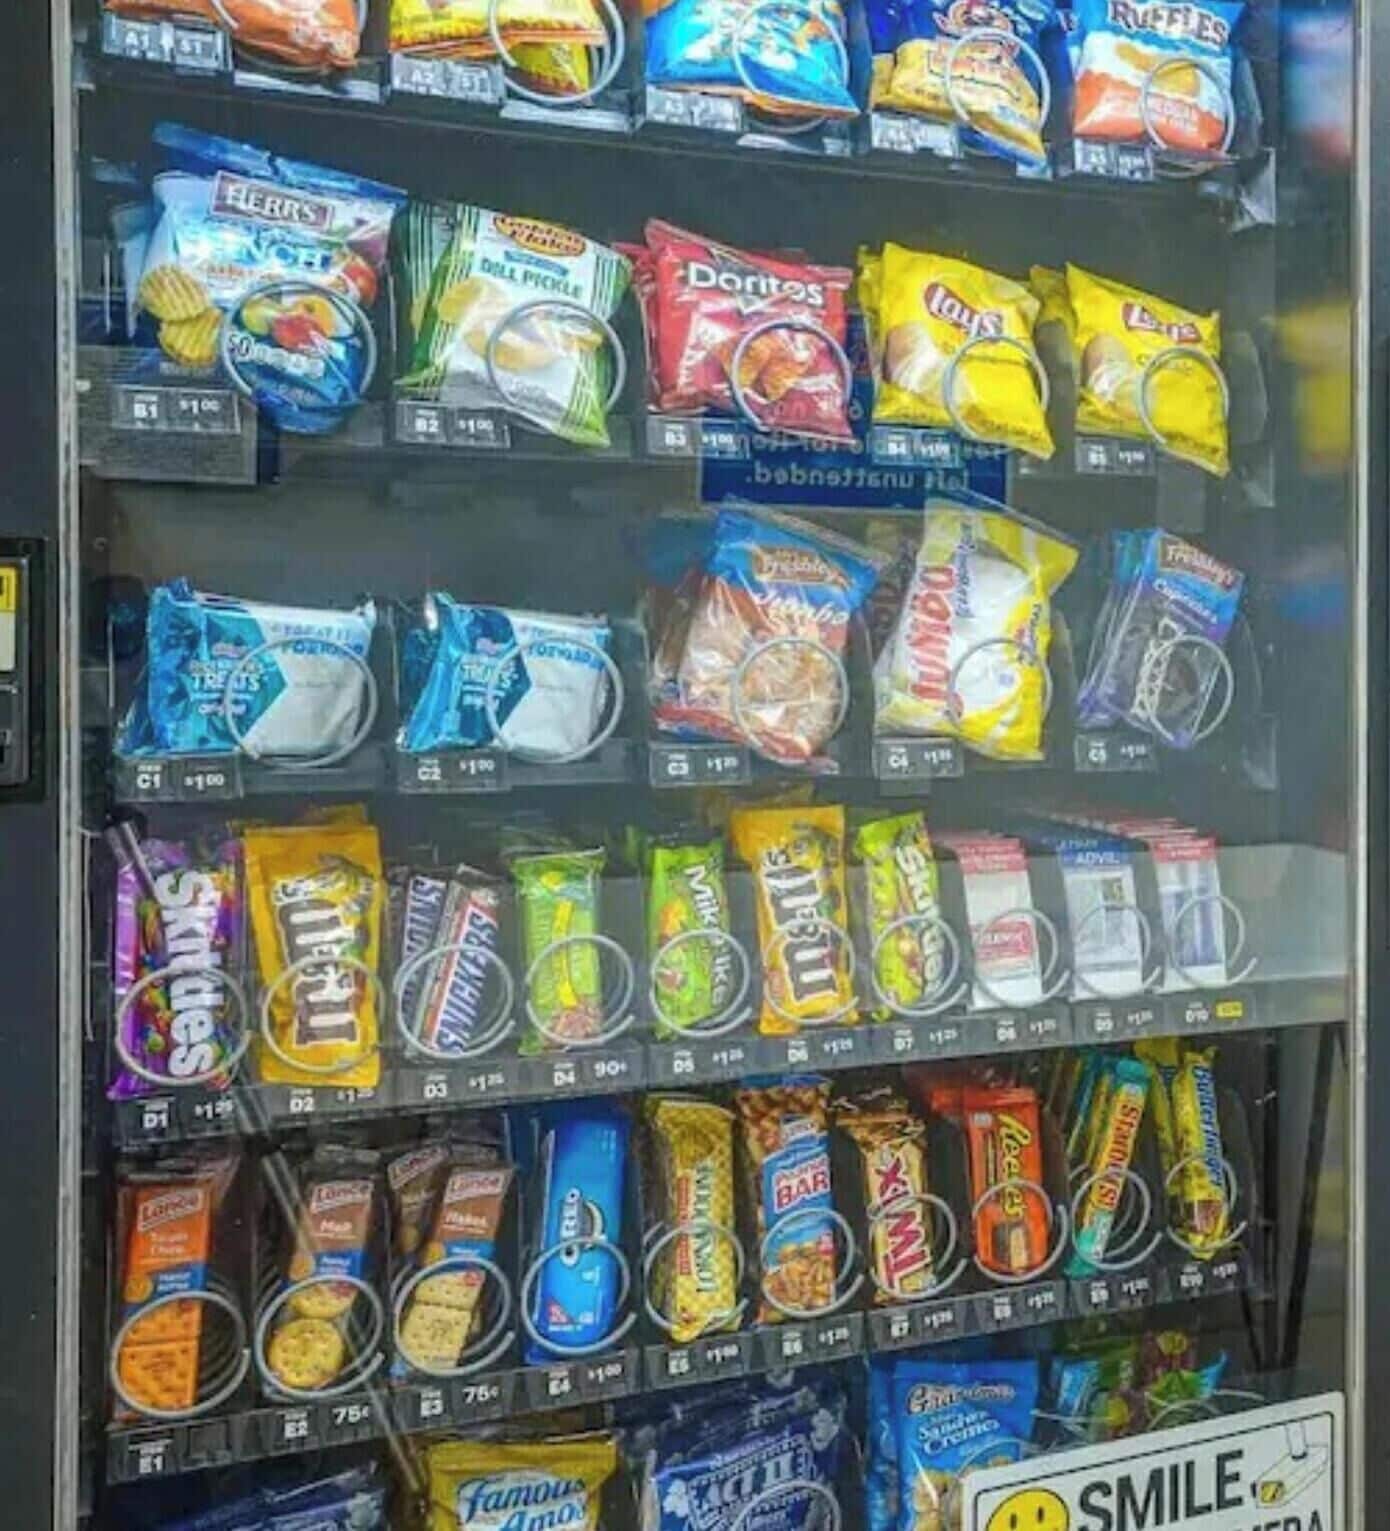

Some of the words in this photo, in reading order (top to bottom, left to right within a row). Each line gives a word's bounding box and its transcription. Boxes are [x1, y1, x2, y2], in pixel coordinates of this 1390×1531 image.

[688, 261, 824, 306] Doritos
[133, 402, 158, 418] B1
[414, 417, 440, 433] B2
[664, 429, 688, 447] B3
[417, 766, 442, 781] C2
[667, 760, 690, 776] C3
[136, 773, 162, 790] C1
[893, 1036, 915, 1051] D7
[673, 1060, 695, 1074] D5
[553, 1072, 576, 1087] D4
[423, 1083, 448, 1099] D3
[288, 1097, 316, 1113] D2
[142, 1112, 169, 1129] D1
[312, 1181, 373, 1208] Lance
[775, 1170, 829, 1211] BAR
[547, 1379, 572, 1396] E4
[420, 1399, 444, 1417] E3
[283, 1421, 310, 1439] E2
[138, 1457, 164, 1475] E1
[456, 1473, 586, 1524] Famous
[1078, 1449, 1246, 1531] SMILE
